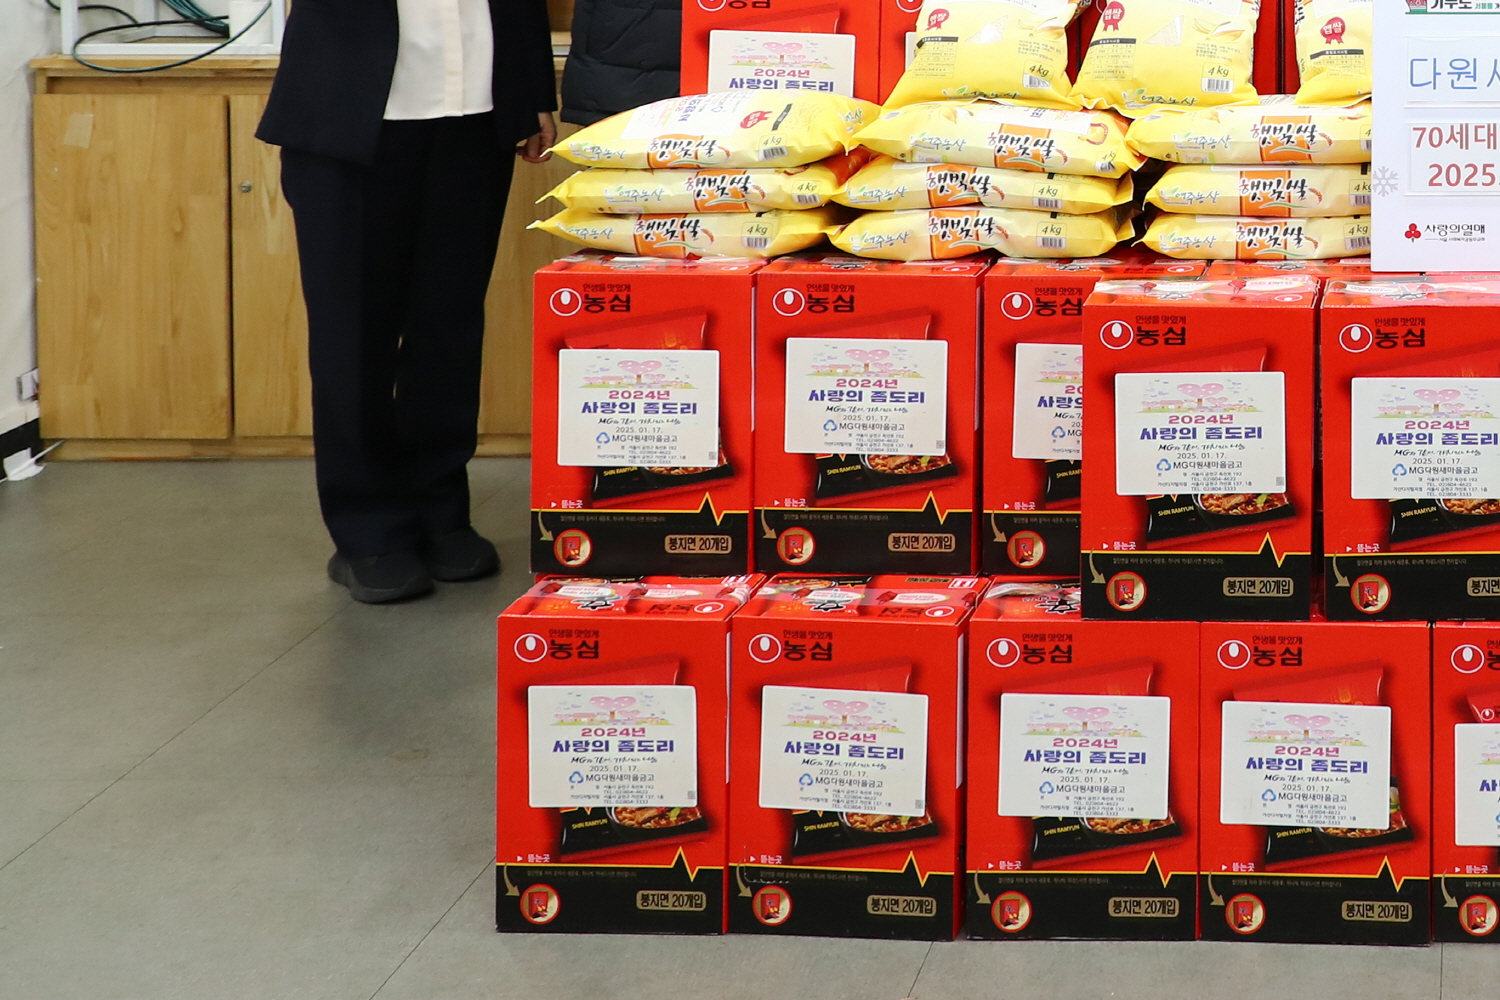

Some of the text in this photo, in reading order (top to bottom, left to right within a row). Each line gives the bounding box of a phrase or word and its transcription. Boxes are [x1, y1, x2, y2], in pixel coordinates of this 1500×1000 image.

[754, 68, 811, 79] 2024년
[729, 78, 834, 92] 사랑의 좀도리
[1424, 223, 1486, 237] 사랑의열매
[583, 294, 630, 312] 농심
[1374, 328, 1426, 348] 농심
[609, 390, 670, 401] 2024년
[581, 401, 697, 415] 사랑의 좀도리
[1405, 420, 1470, 430] 2024년
[1376, 432, 1499, 447] 사랑의 좀도리
[668, 537, 729, 551] 봉지면 20개입
[1472, 579, 1500, 594] 봉지면
[550, 639, 600, 659] 농심
[581, 727, 646, 738] 2024년
[553, 740, 674, 755] 사랑의 좀도리
[1053, 738, 1118, 749] 2024년
[1023, 749, 1147, 765] 사랑의 좀도리
[640, 893, 704, 908] 봉지면 20개입
